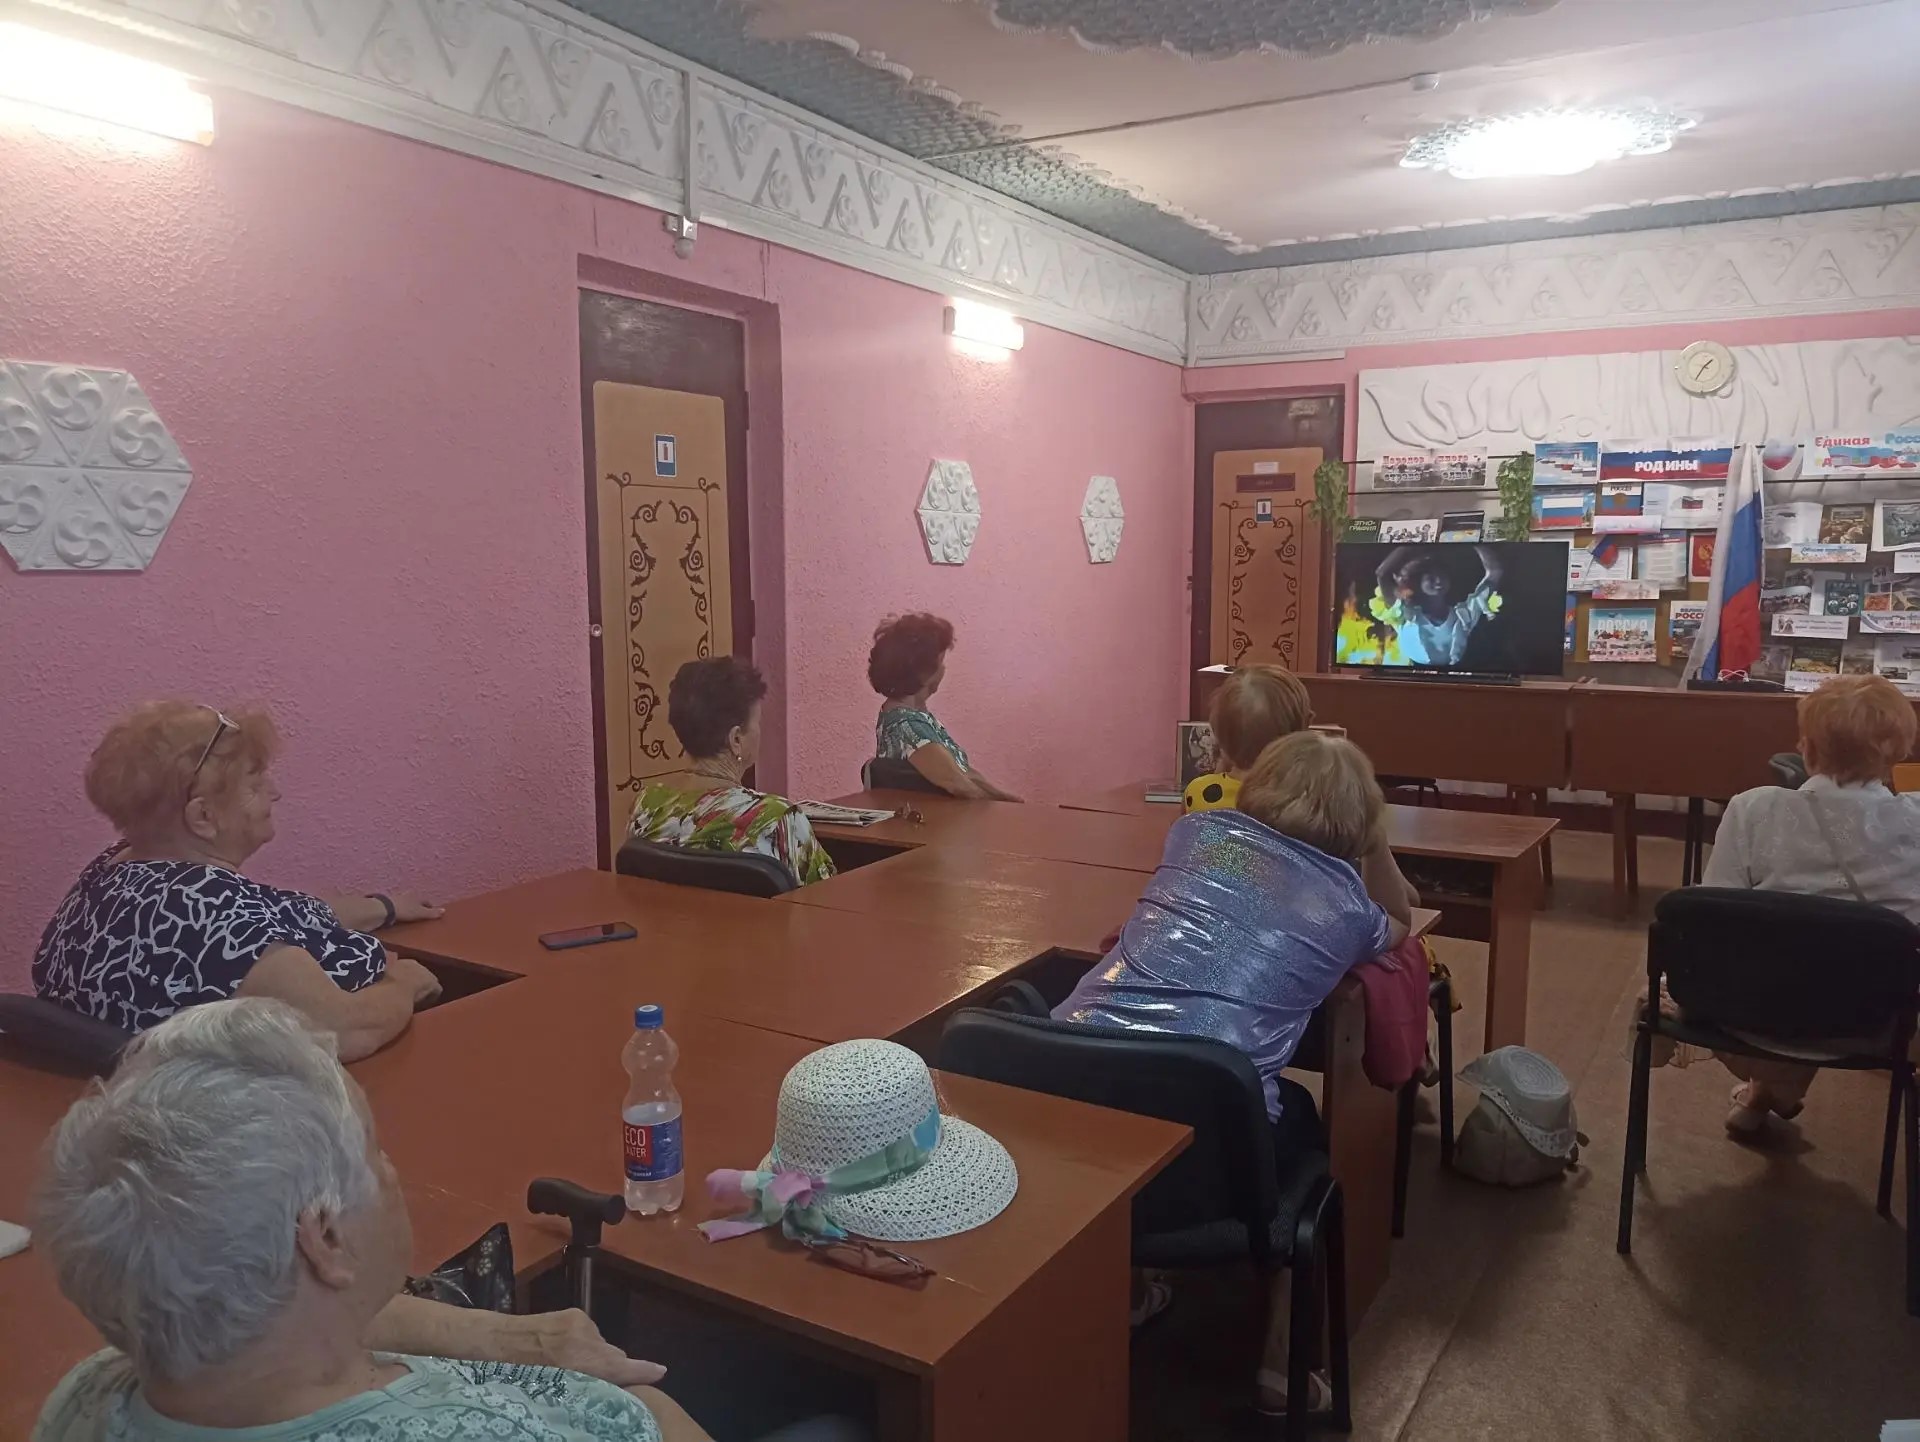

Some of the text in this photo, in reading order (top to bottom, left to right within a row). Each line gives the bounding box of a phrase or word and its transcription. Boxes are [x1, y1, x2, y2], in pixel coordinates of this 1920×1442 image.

[1815, 436, 1870, 448] Единая
[1634, 459, 1698, 473] РОДИНЫ
[625, 1125, 646, 1147] ECO
